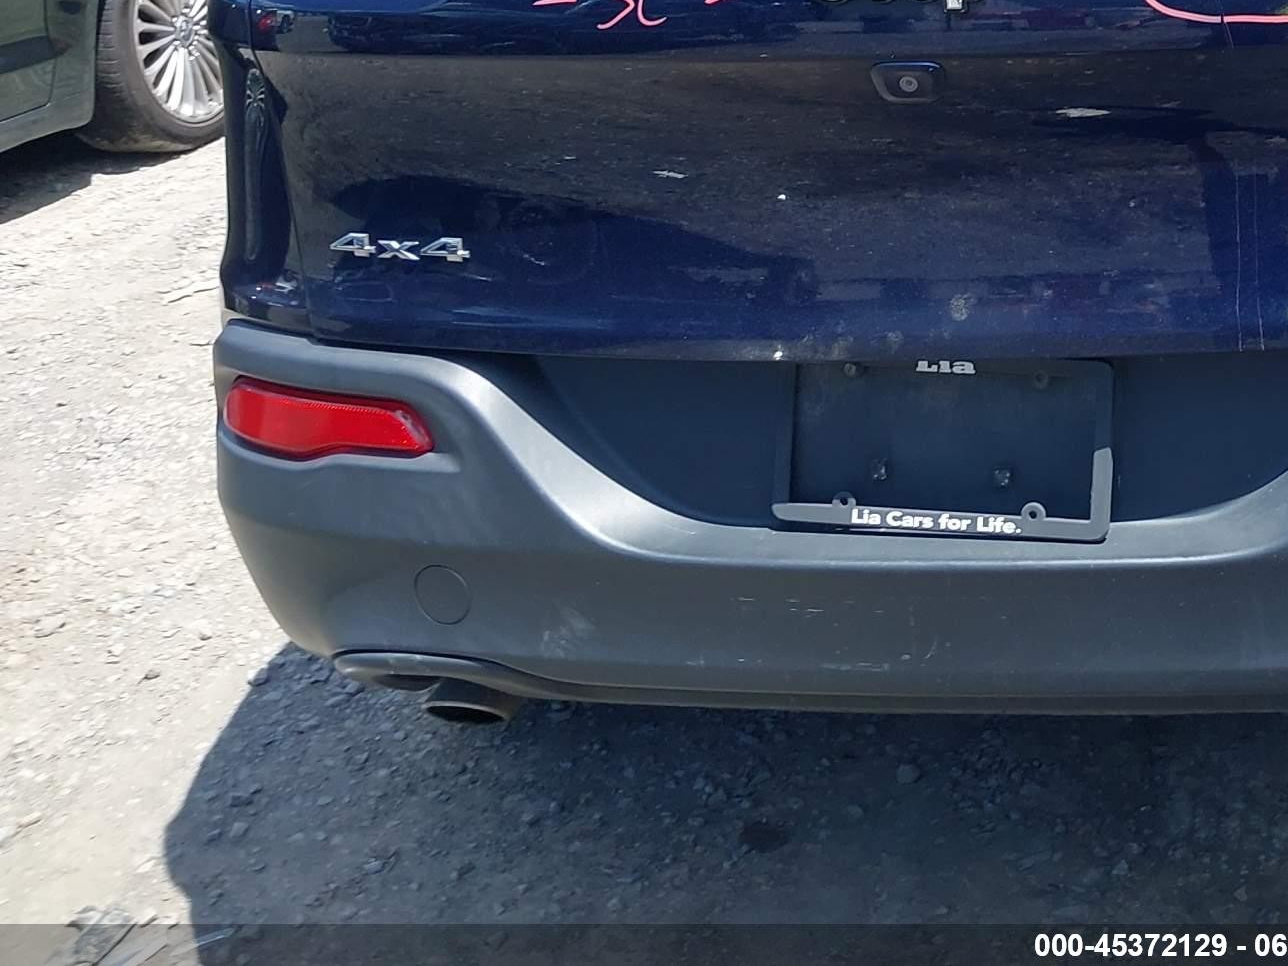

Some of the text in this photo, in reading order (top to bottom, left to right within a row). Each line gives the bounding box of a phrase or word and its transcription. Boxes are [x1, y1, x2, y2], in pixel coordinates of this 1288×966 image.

[329, 233, 471, 262] 4x4
[851, 509, 1022, 534] Lia Cars for Life.
